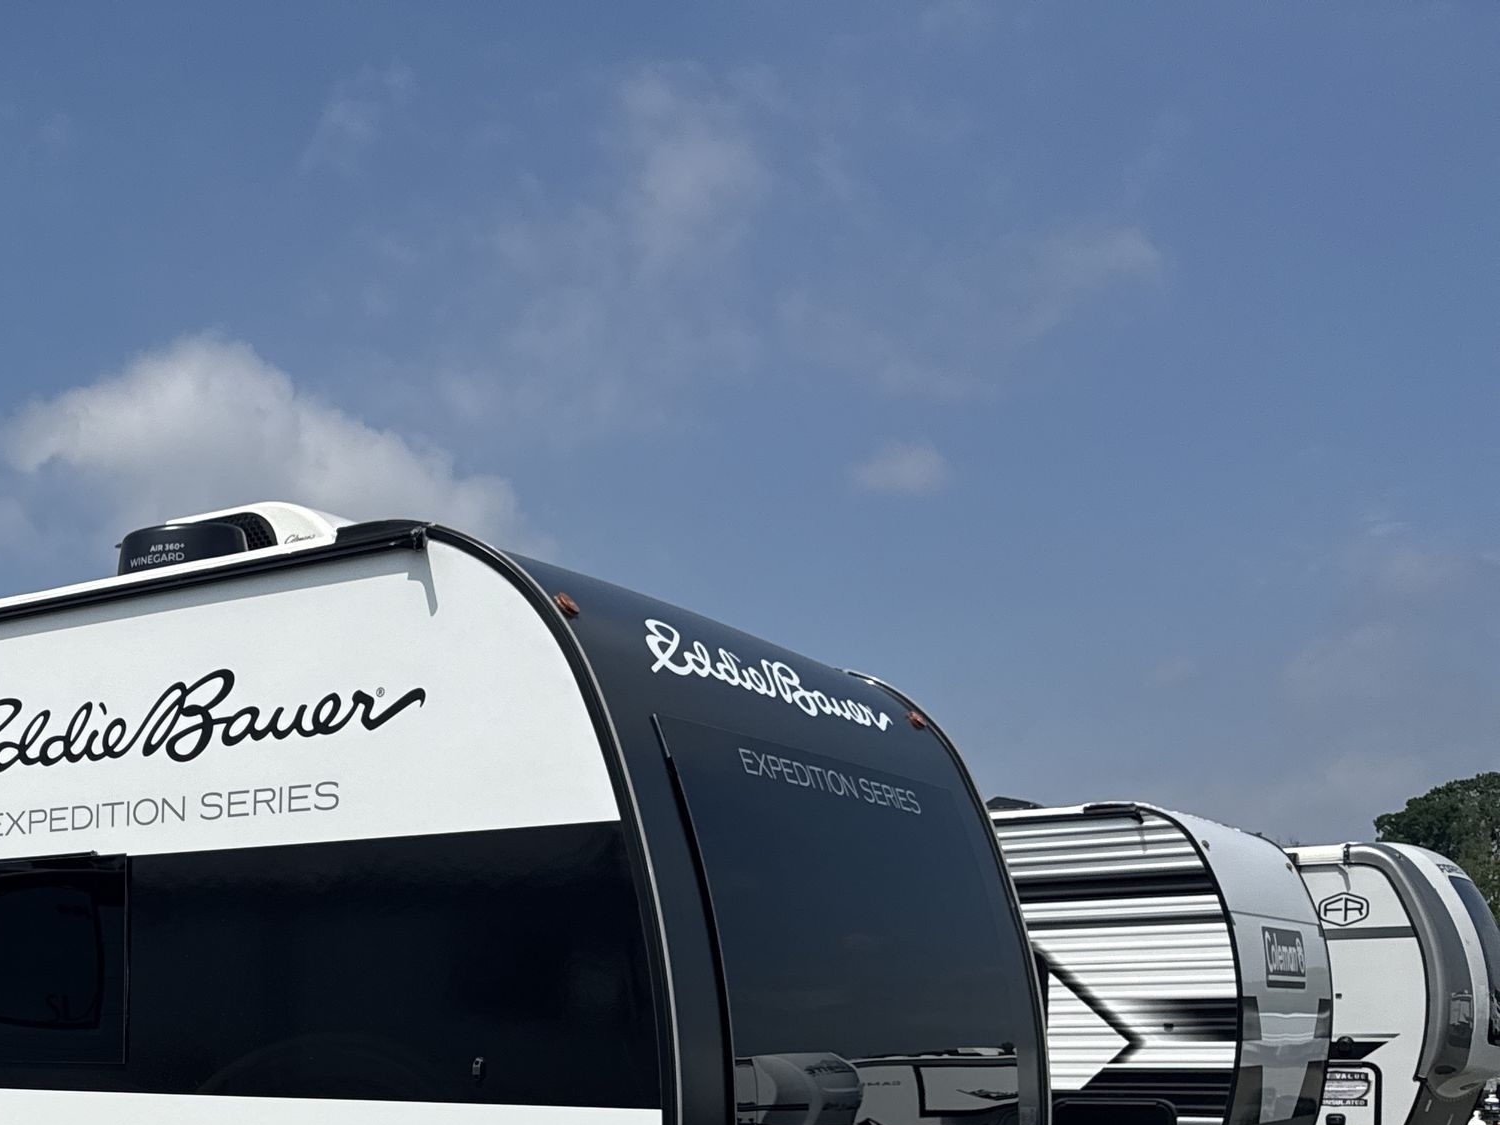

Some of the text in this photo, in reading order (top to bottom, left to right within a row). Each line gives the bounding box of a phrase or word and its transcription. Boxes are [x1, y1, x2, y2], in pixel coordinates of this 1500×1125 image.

[129, 552, 185, 568] WINEGARD
[150, 544, 163, 552] AIR
[738, 748, 921, 814] EXPEDITION SERIES
[200, 782, 340, 822] SERIES
